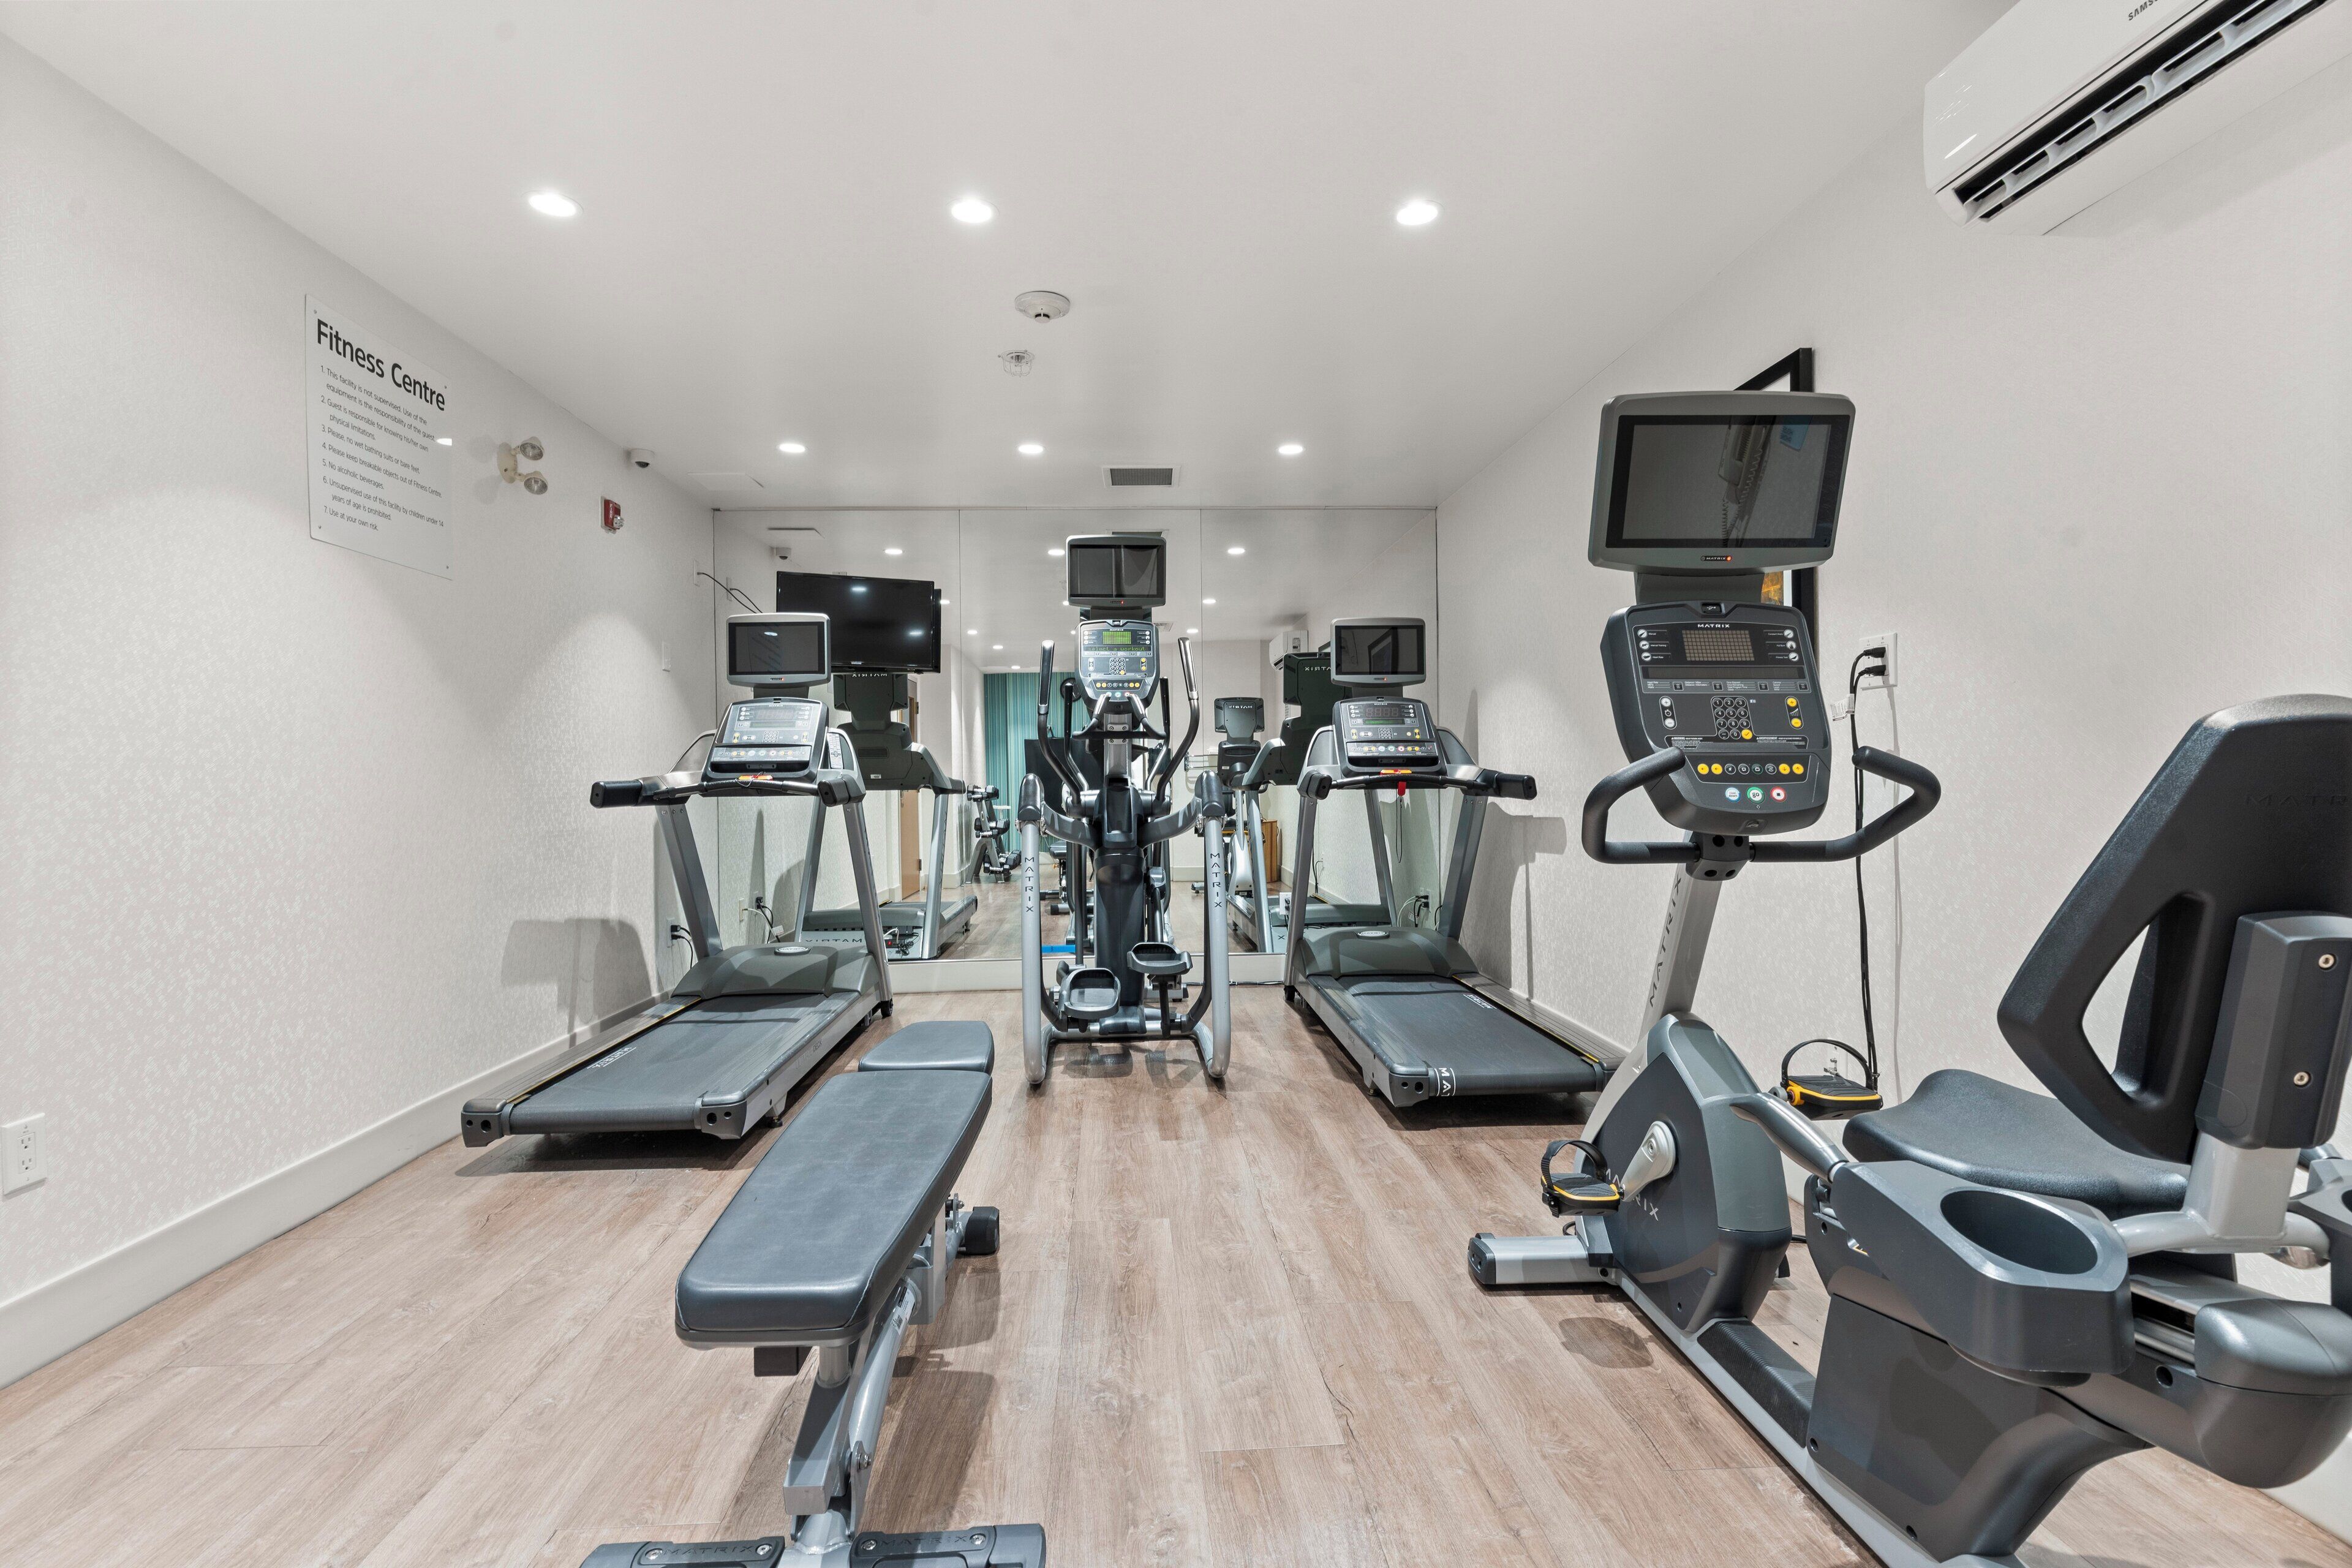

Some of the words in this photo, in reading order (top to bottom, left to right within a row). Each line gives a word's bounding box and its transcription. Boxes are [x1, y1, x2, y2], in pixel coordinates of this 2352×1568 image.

[2128, 0, 2157, 21] SAMS
[317, 318, 385, 378] Fitness
[391, 363, 445, 411] Centre
[326, 368, 338, 380] This
[339, 375, 356, 390] facility
[364, 389, 372, 398] not
[374, 394, 402, 412] supervised.
[403, 407, 412, 418] Use
[326, 383, 357, 403] equipment
[364, 401, 373, 411] the
[374, 407, 406, 428] responsibility
[321, 395, 326, 404] 2.
[327, 398, 342, 412] Guest
[349, 410, 375, 428] responsible
[384, 426, 403, 441] knowing
[404, 435, 418, 447] his/her
[330, 415, 350, 429] physical
[351, 423, 376, 440] limitations.
[322, 424, 326, 433] 3.
[355, 440, 364, 449] wet
[365, 443, 382, 458] bathing
[383, 453, 394, 462] suits
[400, 459, 410, 469] bare
[411, 464, 420, 473] feet.
[328, 444, 345, 458] Please
[346, 451, 358, 463] keep
[359, 458, 382, 473] breakable
[383, 469, 399, 480] objects
[413, 480, 428, 492] Fitness
[329, 461, 336, 470] No
[337, 466, 358, 479] alcoholic
[360, 473, 384, 489] beverages.
[329, 508, 339, 518] Use
[358, 519, 369, 527] own
[369, 522, 379, 531] risk.
[330, 478, 362, 497] Unsupervised
[388, 501, 401, 513] facility
[409, 509, 425, 521] children
[426, 516, 438, 525] under
[331, 494, 345, 503] years
[368, 507, 391, 521] prohibited.
[1025, 857, 1035, 912] MATRIX
[1210, 853, 1222, 907] MATRIX
[1649, 873, 1681, 1008] MATRIX
[1466, 995, 1493, 1009] MATRIX
[663, 1545, 754, 1556] MATRIX
[882, 1536, 967, 1546] MATRIX
